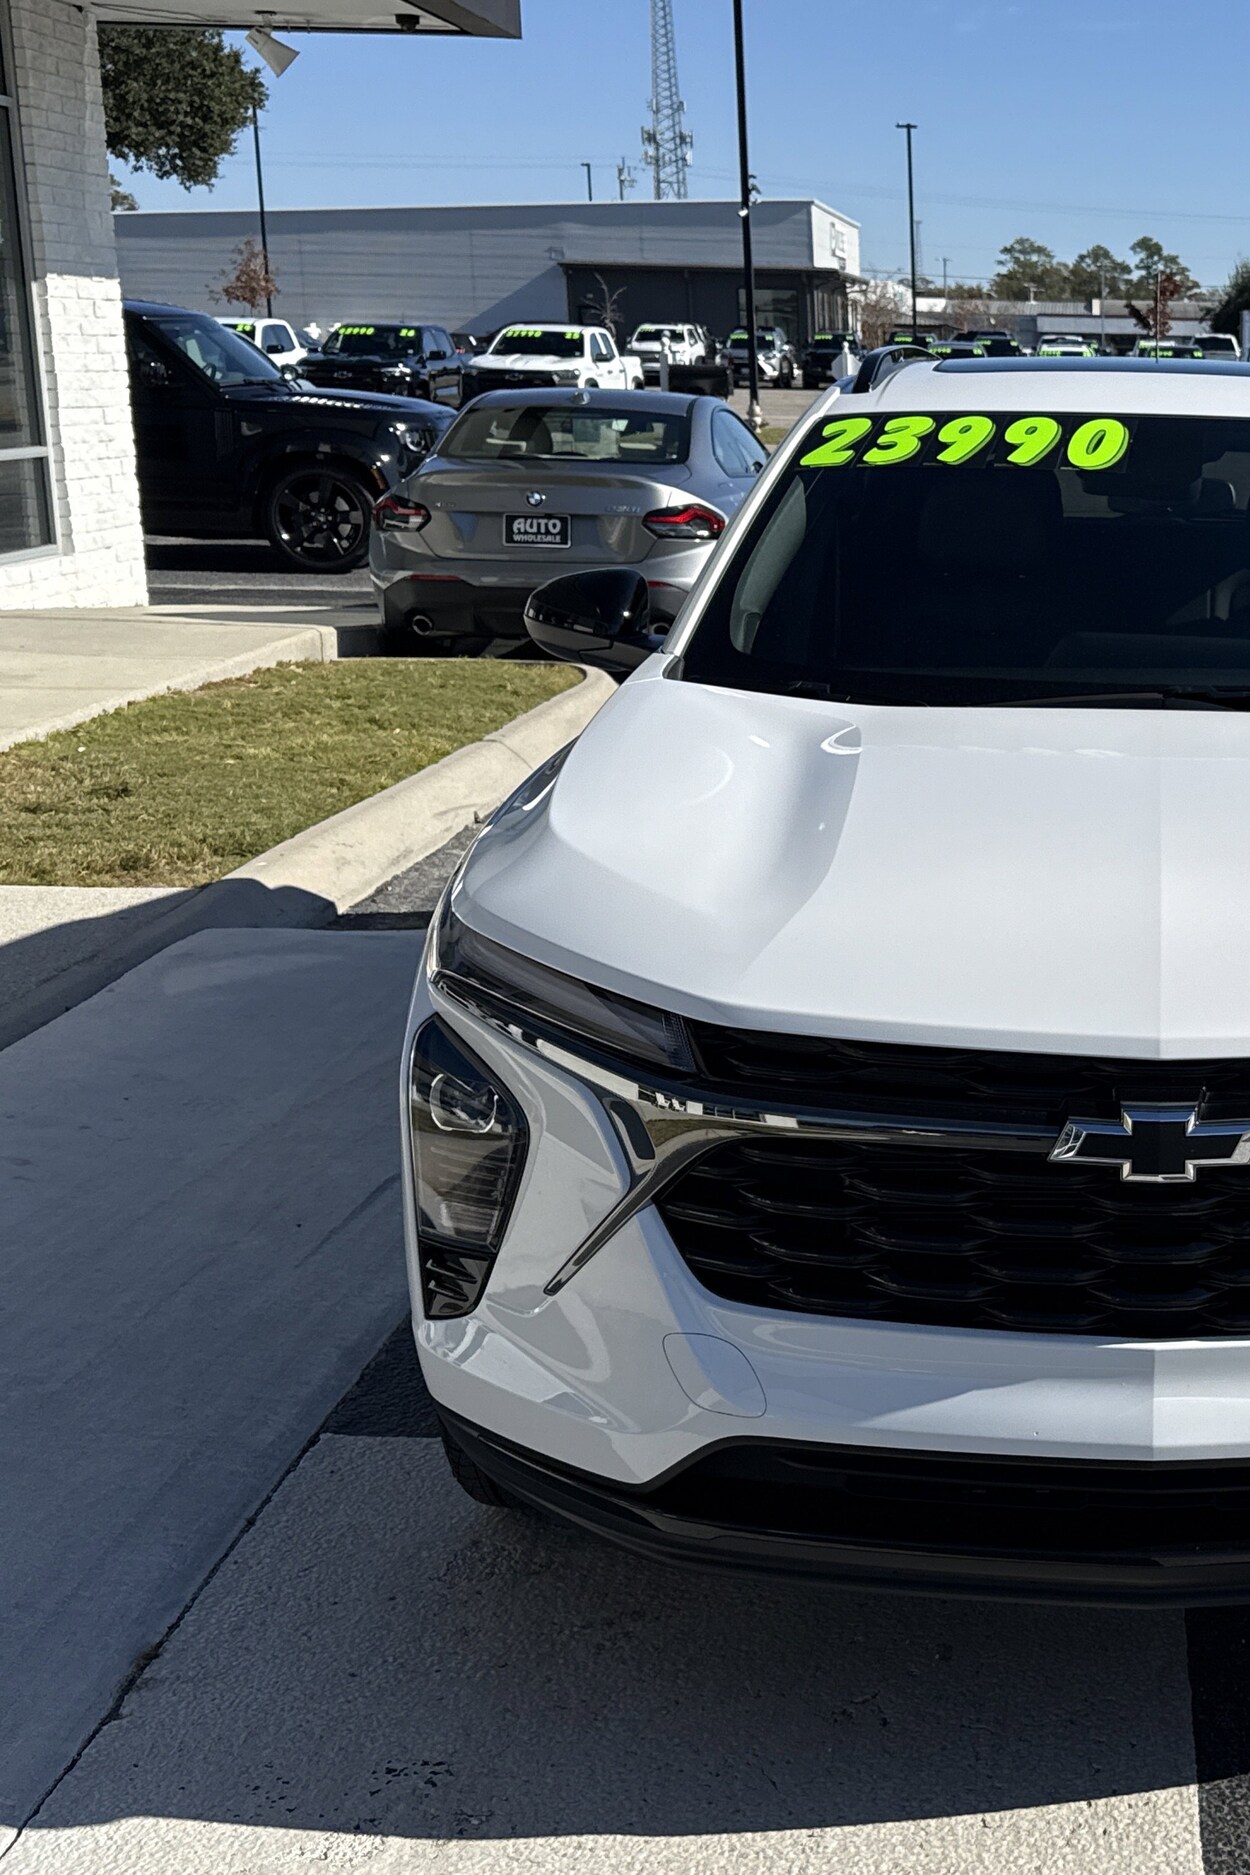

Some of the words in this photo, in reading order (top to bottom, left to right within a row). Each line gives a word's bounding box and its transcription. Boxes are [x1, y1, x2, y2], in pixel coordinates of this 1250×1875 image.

[799, 415, 1132, 471] 23990
[512, 518, 561, 534] AUTO
[513, 533, 561, 543] WHOLESALE
